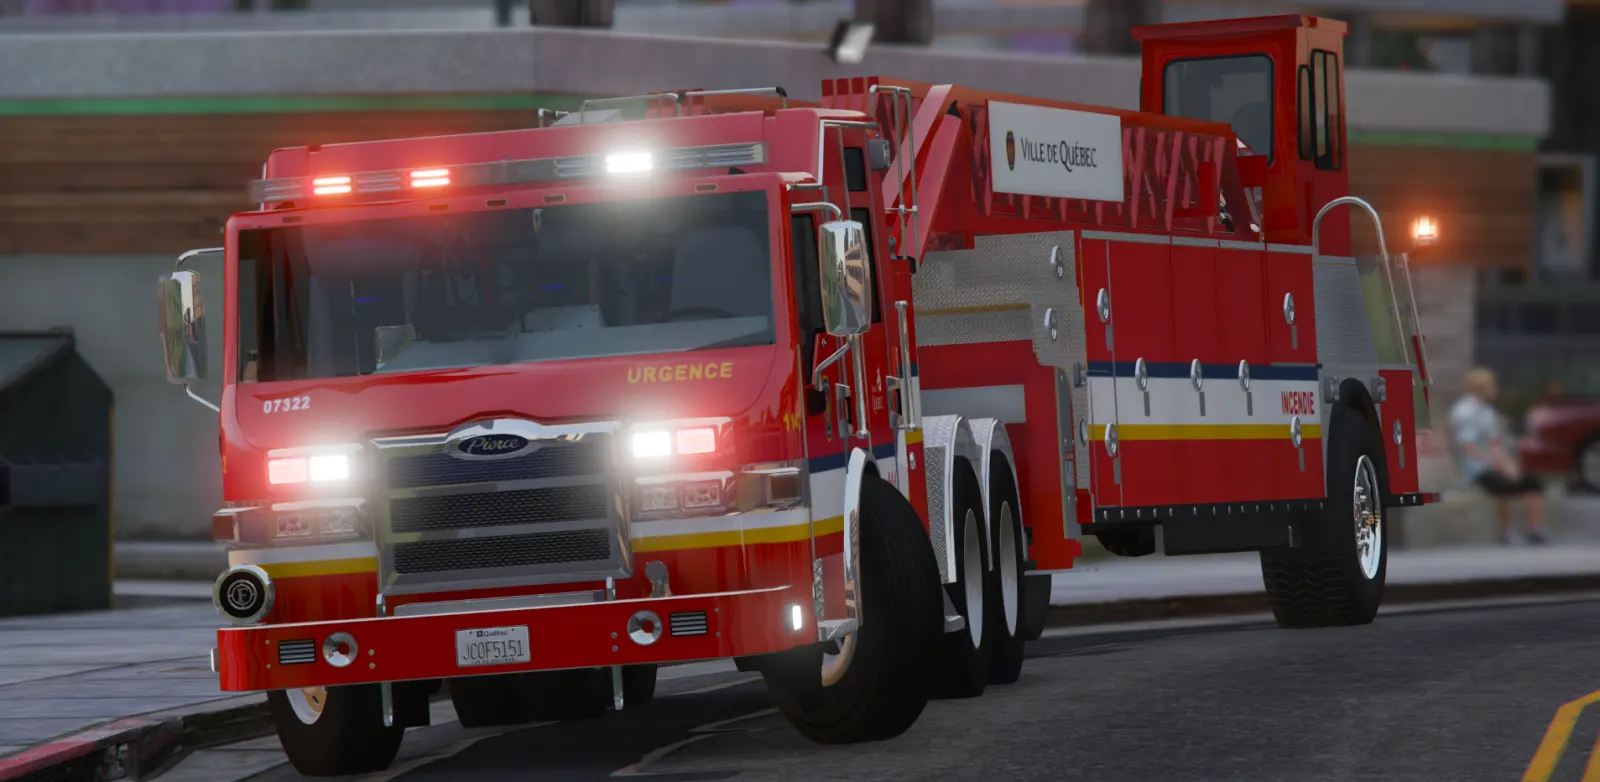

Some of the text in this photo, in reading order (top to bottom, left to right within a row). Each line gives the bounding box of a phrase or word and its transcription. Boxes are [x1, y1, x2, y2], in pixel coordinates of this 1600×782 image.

[1020, 137, 1046, 163] VILLE
[1047, 143, 1059, 164] DE
[627, 361, 734, 384] URGENCE
[263, 396, 311, 415] 07322
[1280, 391, 1315, 416] INCENDIE
